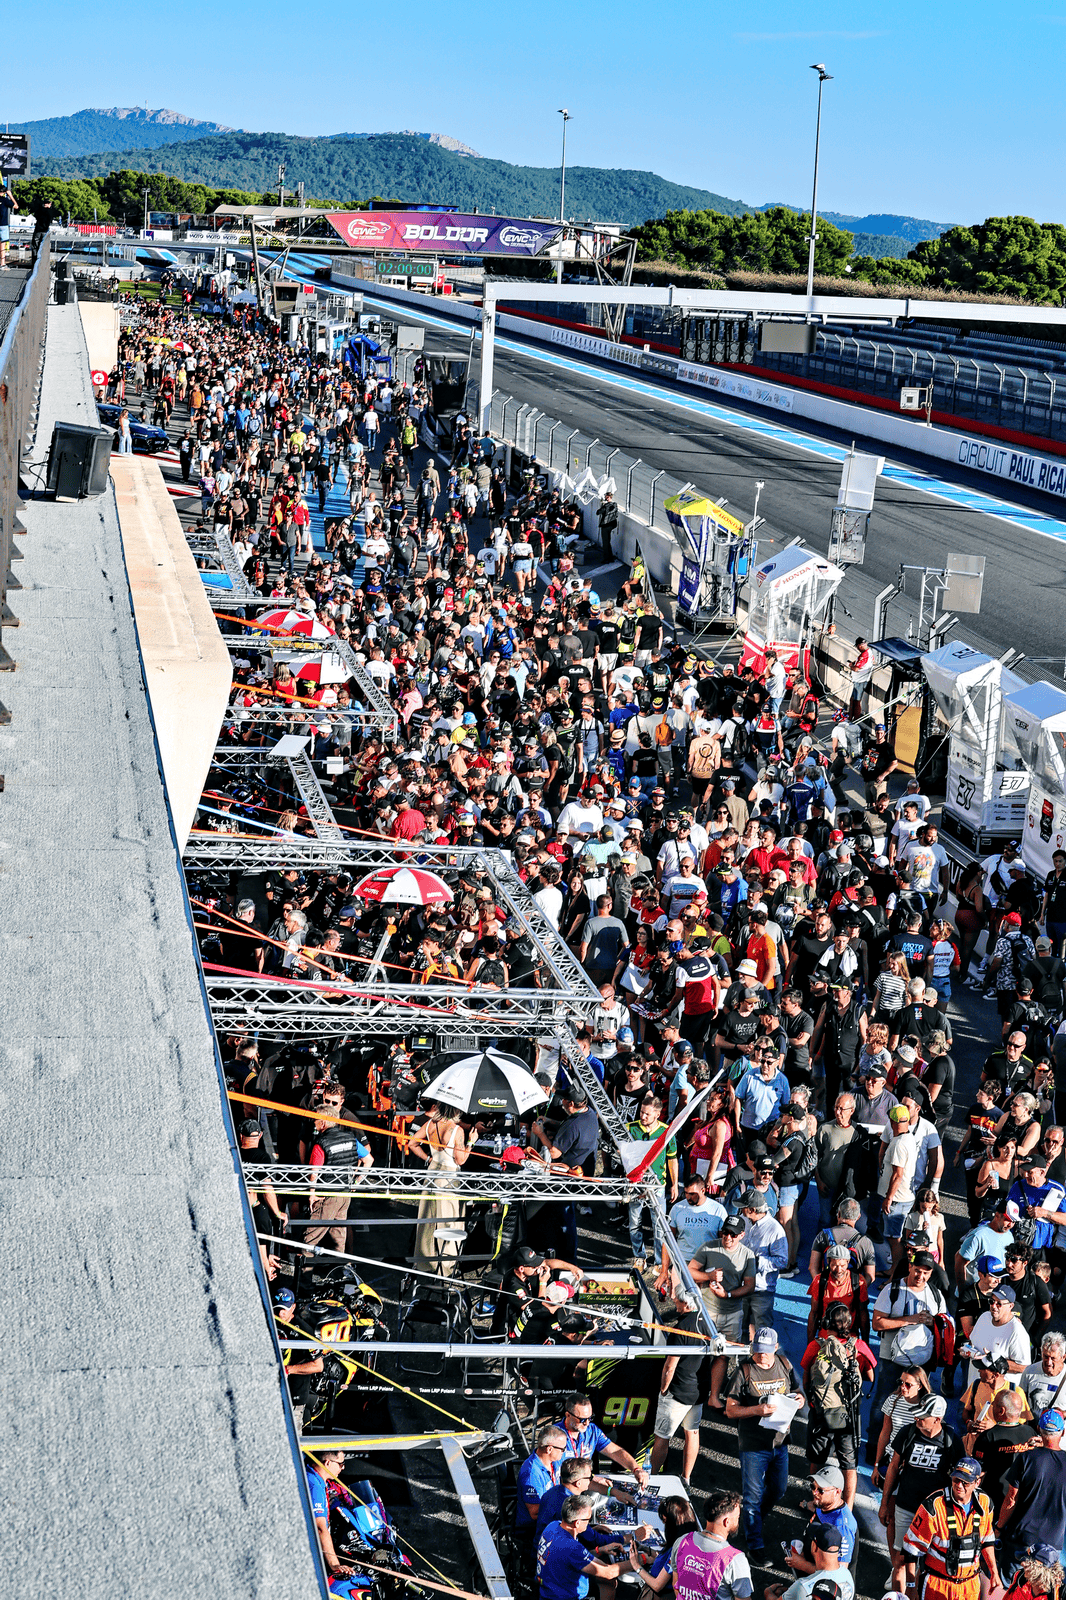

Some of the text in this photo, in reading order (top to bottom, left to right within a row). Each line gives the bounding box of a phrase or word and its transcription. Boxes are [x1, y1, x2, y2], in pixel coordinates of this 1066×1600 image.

[353, 227, 376, 236] EWC
[505, 234, 529, 243] EWC
[378, 262, 432, 275] 02:00:00
[958, 440, 1007, 474] CIRCUIT
[1008, 453, 1035, 485] PAUL
[782, 566, 811, 585] HONDA
[998, 776, 1025, 790] 37
[956, 774, 976, 811] 37
[480, 1097, 508, 1105] alpha
[684, 1216, 709, 1224] BOSS
[602, 1396, 650, 1426] 90
[914, 1442, 942, 1457] BOL
[687, 1558, 705, 1572] EWC
